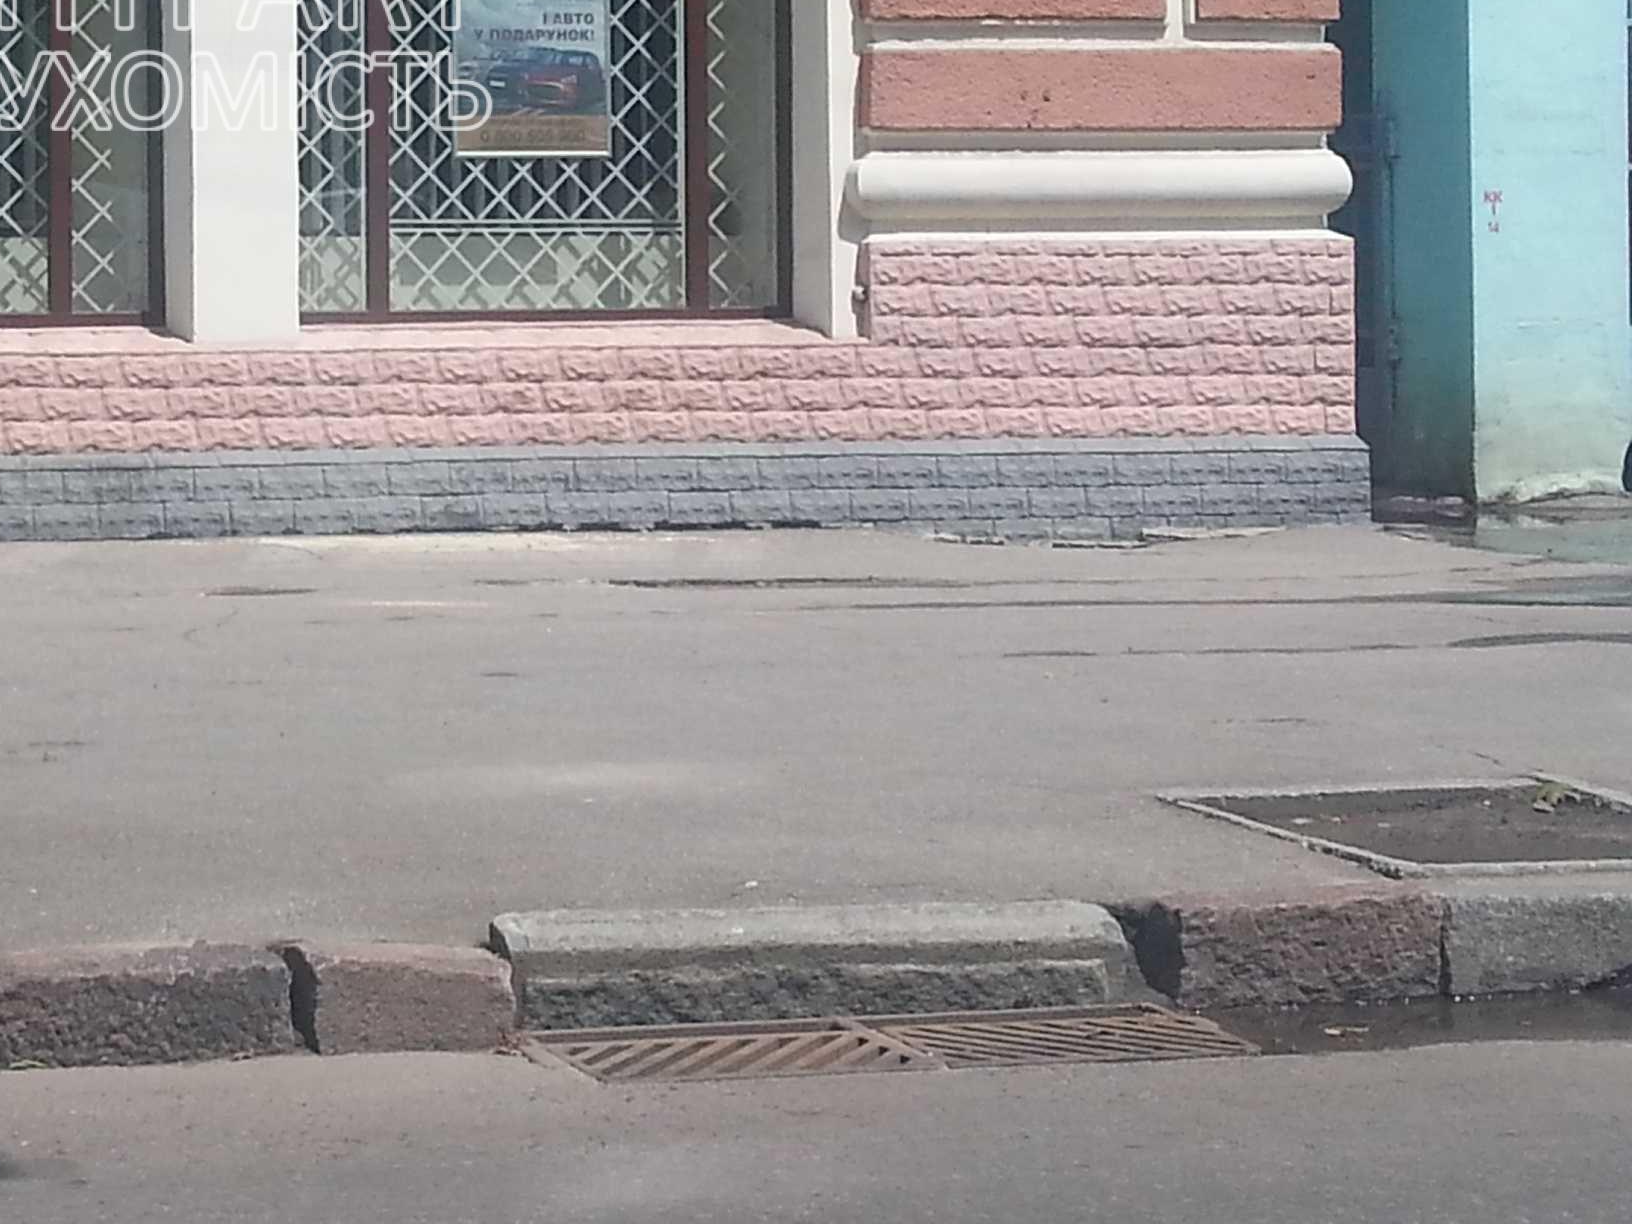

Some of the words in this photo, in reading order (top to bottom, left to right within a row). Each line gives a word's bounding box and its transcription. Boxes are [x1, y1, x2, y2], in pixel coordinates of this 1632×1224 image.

[552, 12, 595, 25] АВТО
[473, 28, 485, 41] У
[489, 28, 595, 42] ПОДАРУНОК!
